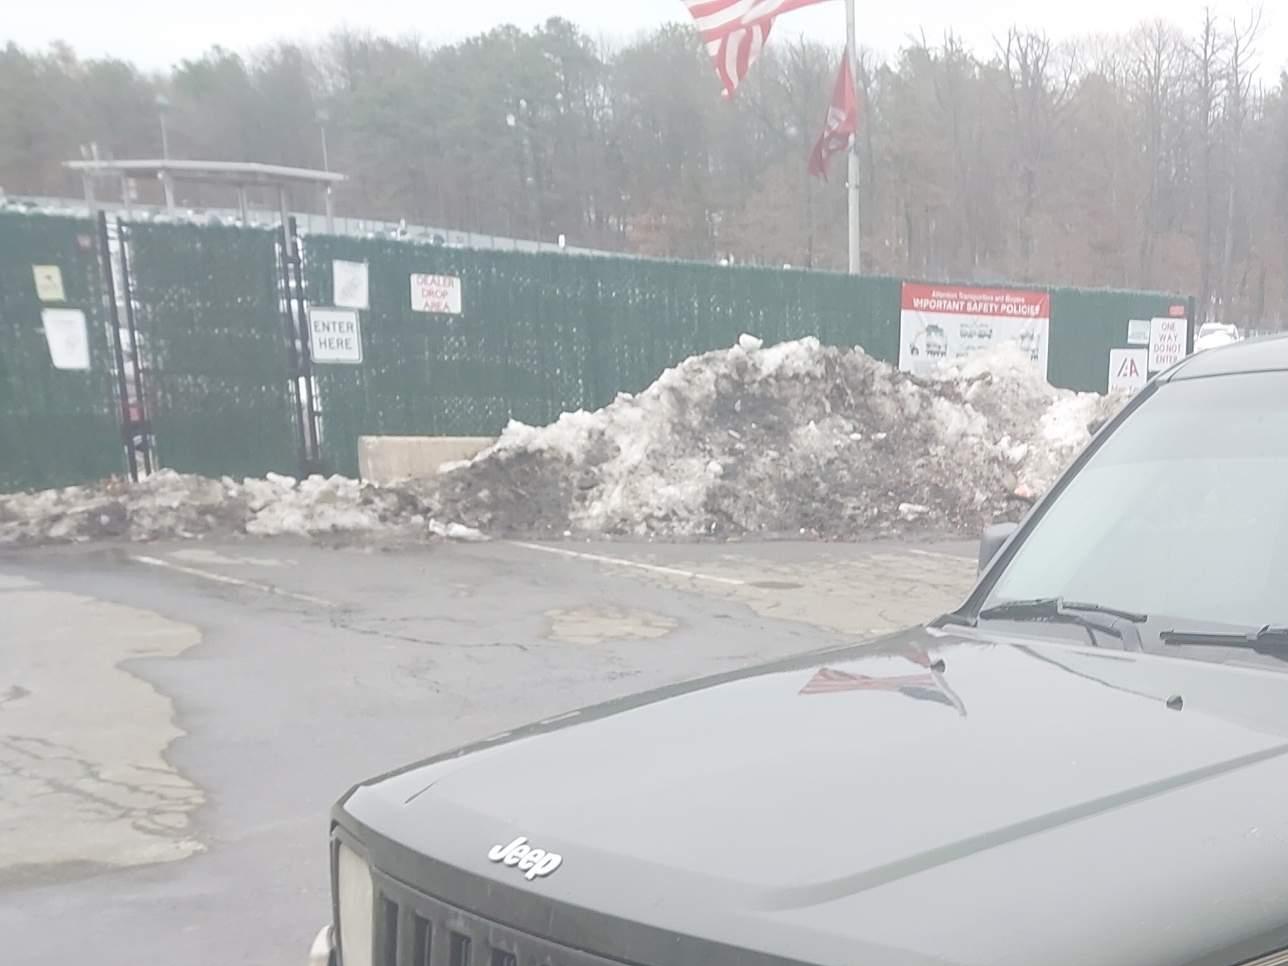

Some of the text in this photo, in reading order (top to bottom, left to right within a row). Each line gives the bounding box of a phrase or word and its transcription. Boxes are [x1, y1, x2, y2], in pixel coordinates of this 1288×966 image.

[416, 275, 455, 289] DEALER
[421, 287, 449, 299] DROP
[423, 300, 450, 312] AREA
[912, 297, 1041, 316] IMPORTANT SAFETY POLICIES
[313, 320, 354, 334] ENTER
[318, 336, 353, 350] HERE
[488, 836, 563, 880] Jeep
